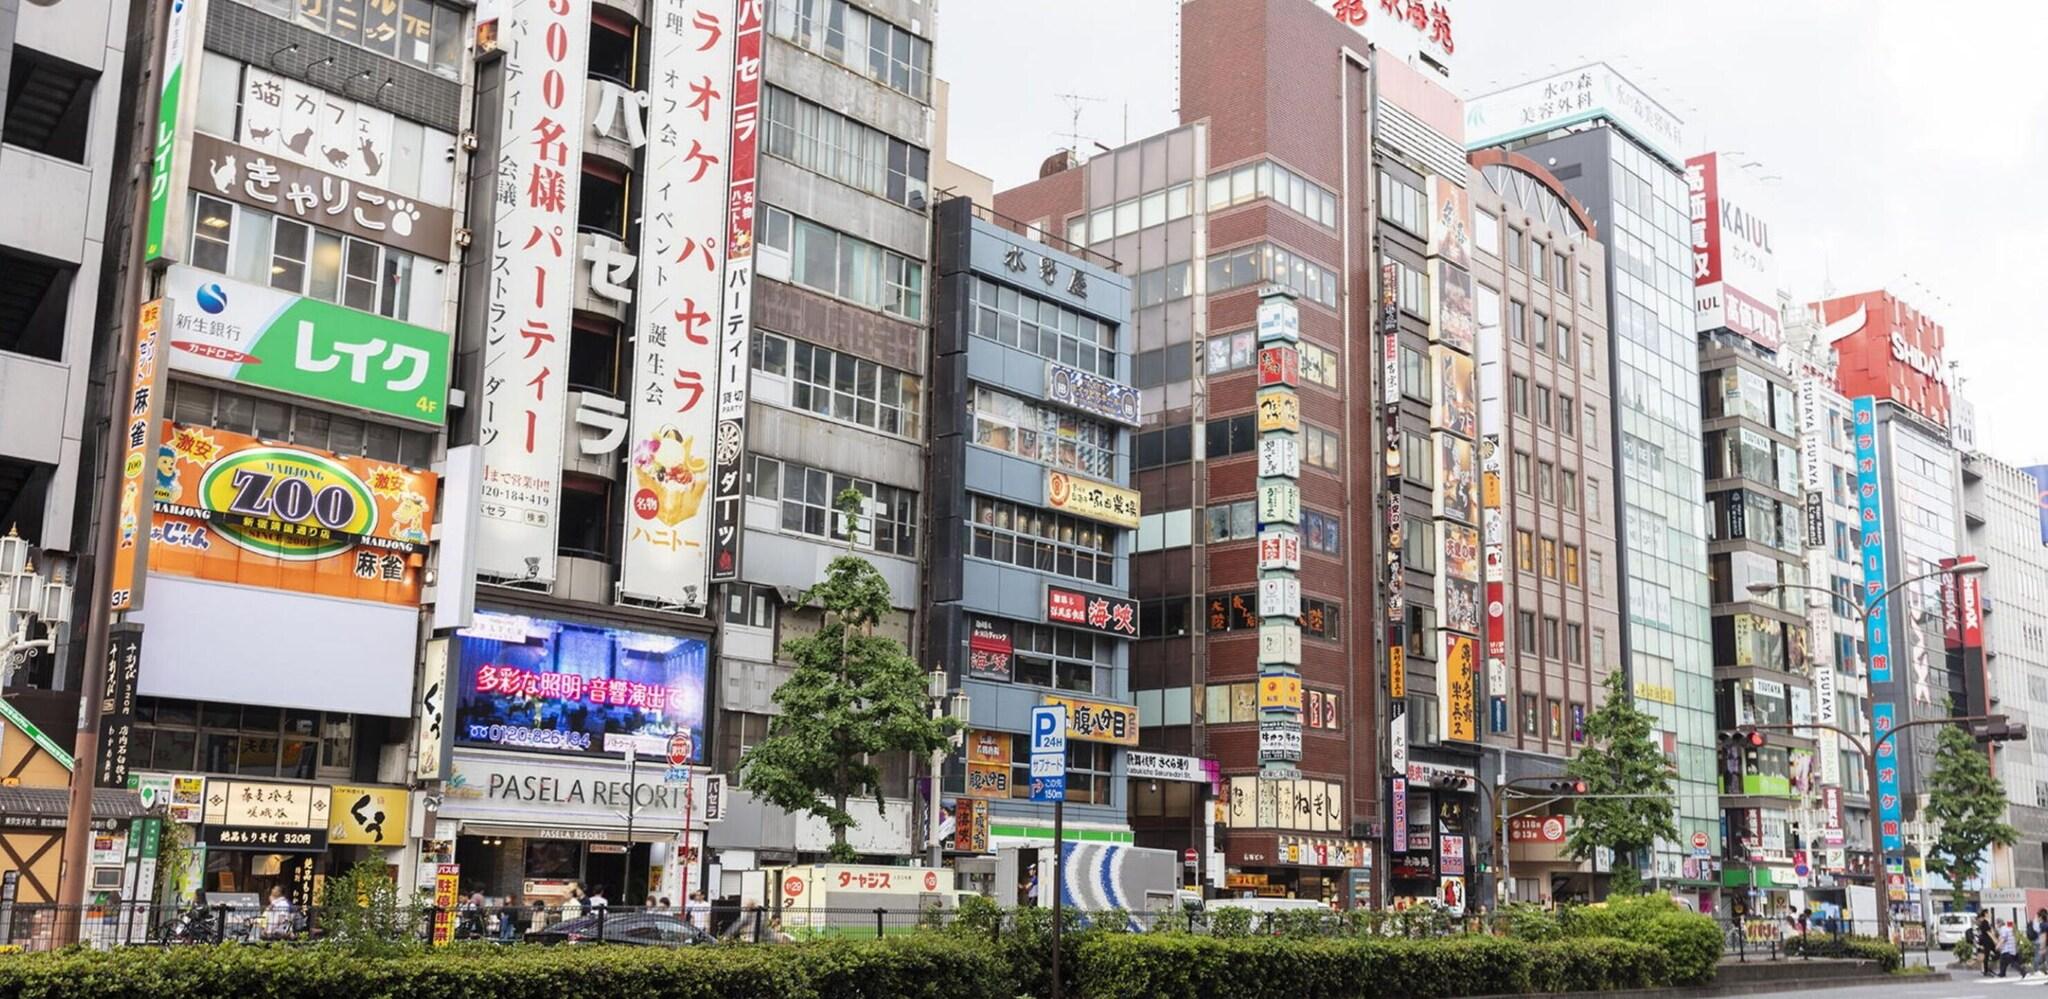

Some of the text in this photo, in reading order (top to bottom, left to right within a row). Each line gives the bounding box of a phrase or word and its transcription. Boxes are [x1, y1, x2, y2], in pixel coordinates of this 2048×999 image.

[1543, 72, 1593, 99] 水の森
[250, 80, 371, 133] 猫カフェ
[1520, 90, 1593, 123] 美容外科
[151, 120, 174, 202] レイク
[244, 157, 386, 231] きゃりこ
[1720, 198, 1773, 256] KAIUL
[1696, 295, 1721, 311] IUL
[176, 312, 241, 342] 新生銀行
[727, 267, 748, 384] パーティー
[187, 342, 246, 363] カードローン
[295, 320, 431, 392] レイク
[130, 387, 151, 449] 麻雀
[415, 396, 437, 414] 4F
[1803, 380, 1814, 429] TSUTAYA
[176, 432, 214, 461] 激安
[1806, 437, 1818, 486] TSUTAYA
[265, 461, 325, 481] MAHJONG
[373, 471, 406, 493] 激安
[481, 464, 551, 493] まで営業中!!
[228, 467, 357, 530] ZOO
[635, 496, 659, 513] 名物
[717, 468, 740, 546] ダーツ
[360, 534, 414, 552] MAHJONG
[632, 526, 700, 552] ハニトー
[355, 550, 403, 582] 麻雀
[111, 590, 129, 606] 3F
[1962, 575, 1979, 630] HIDAX
[1087, 596, 1136, 635] 海峡
[1820, 669, 1833, 720] TSUTAYA
[1035, 711, 1057, 748] P
[1072, 705, 1126, 738] 腹八分目
[1043, 736, 1063, 748] 24H
[1158, 756, 1190, 771] さくら通り
[1876, 716, 1898, 836] カラオケ館
[488, 772, 698, 812] PASELA RESORTS
[969, 770, 1007, 791] 腹八分目
[1044, 789, 1063, 800] 150m
[707, 781, 719, 818] パセラ
[1293, 790, 1341, 820] ねぎし
[219, 830, 312, 845] 絶品もりそば 320円
[540, 829, 608, 842] PASELA RESORTS
